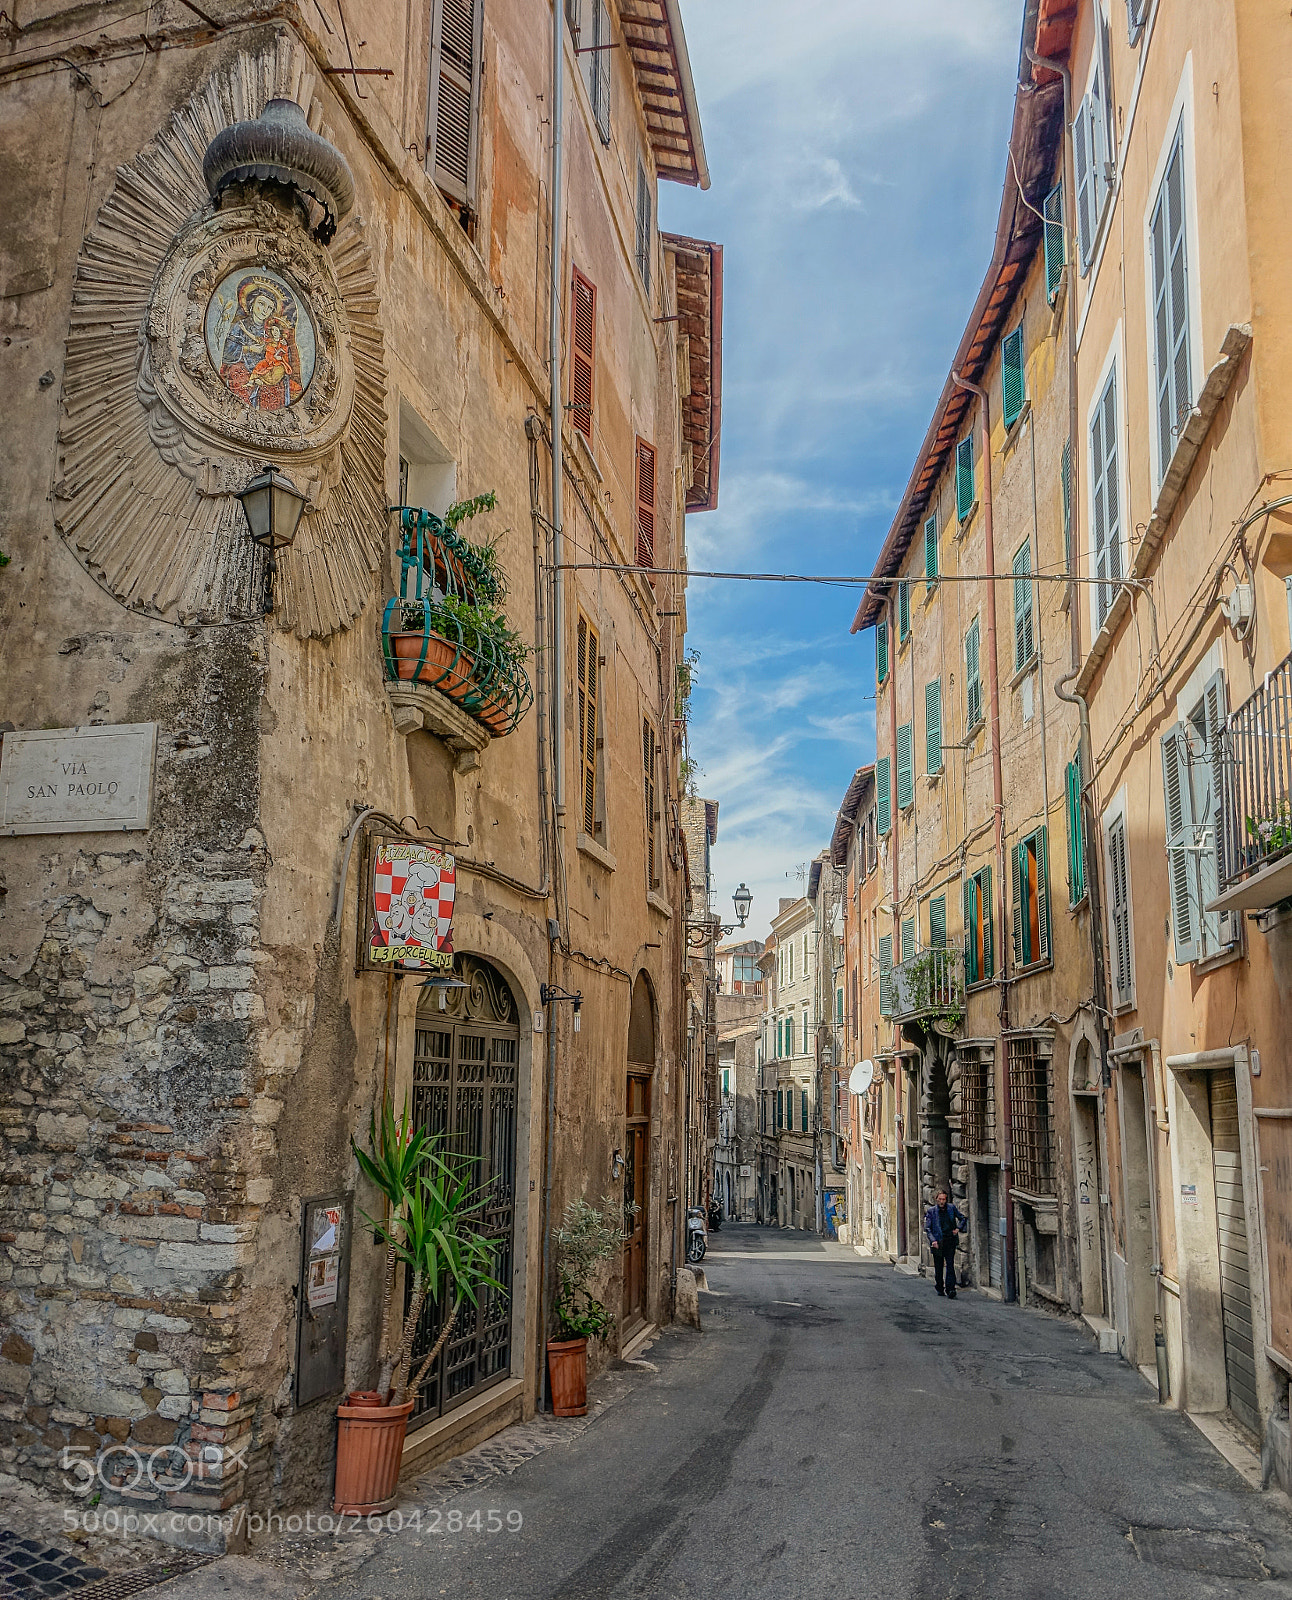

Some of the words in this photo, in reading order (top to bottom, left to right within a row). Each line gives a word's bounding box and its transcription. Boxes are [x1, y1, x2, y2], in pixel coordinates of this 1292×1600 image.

[61, 762, 88, 775] VIA
[27, 784, 59, 799] SAN
[67, 781, 119, 797] PAOLO
[372, 948, 379, 960] I
[382, 947, 390, 961] 3
[391, 946, 452, 967] PORCELLINI
